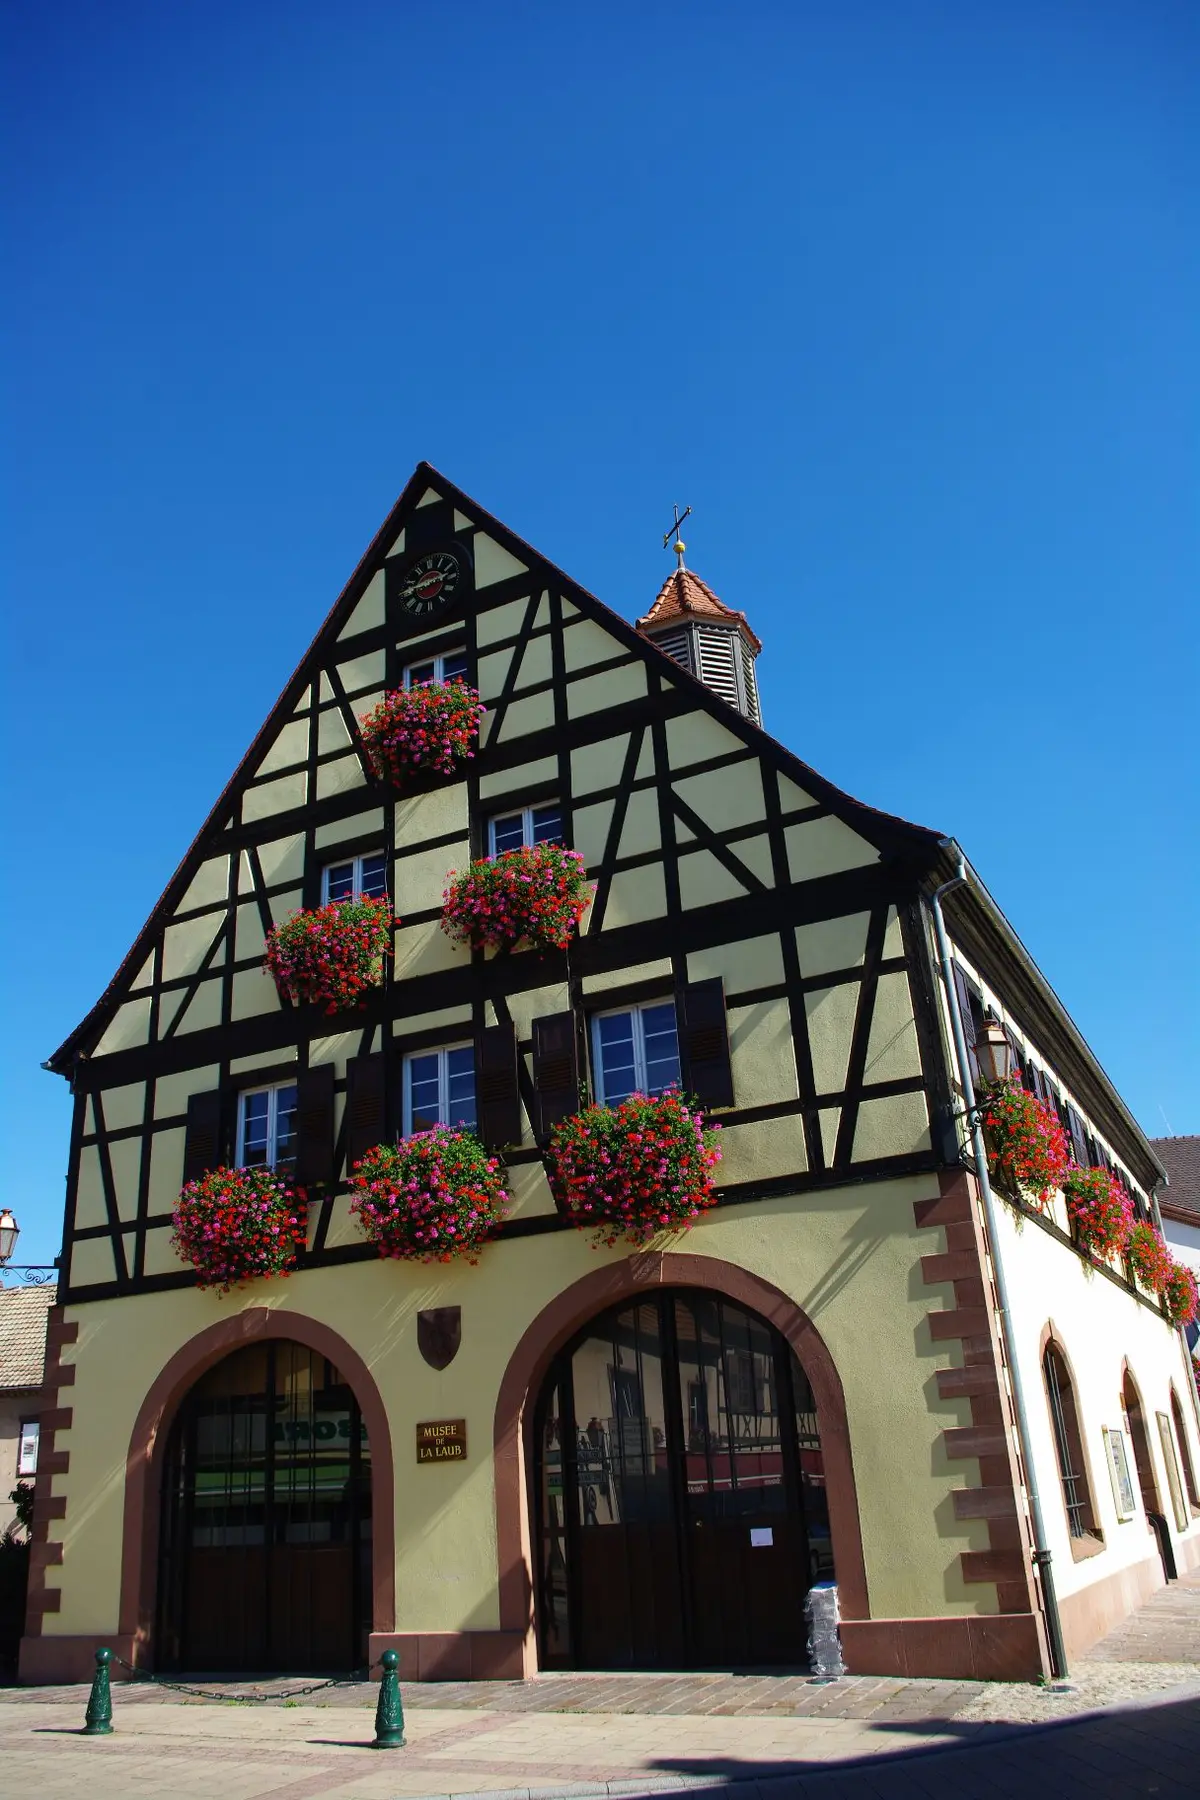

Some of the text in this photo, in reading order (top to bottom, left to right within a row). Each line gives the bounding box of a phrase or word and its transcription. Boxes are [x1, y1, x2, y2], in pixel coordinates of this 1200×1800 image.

[423, 1425, 457, 1438] MUSEE
[420, 1445, 462, 1459] LA LAUB
